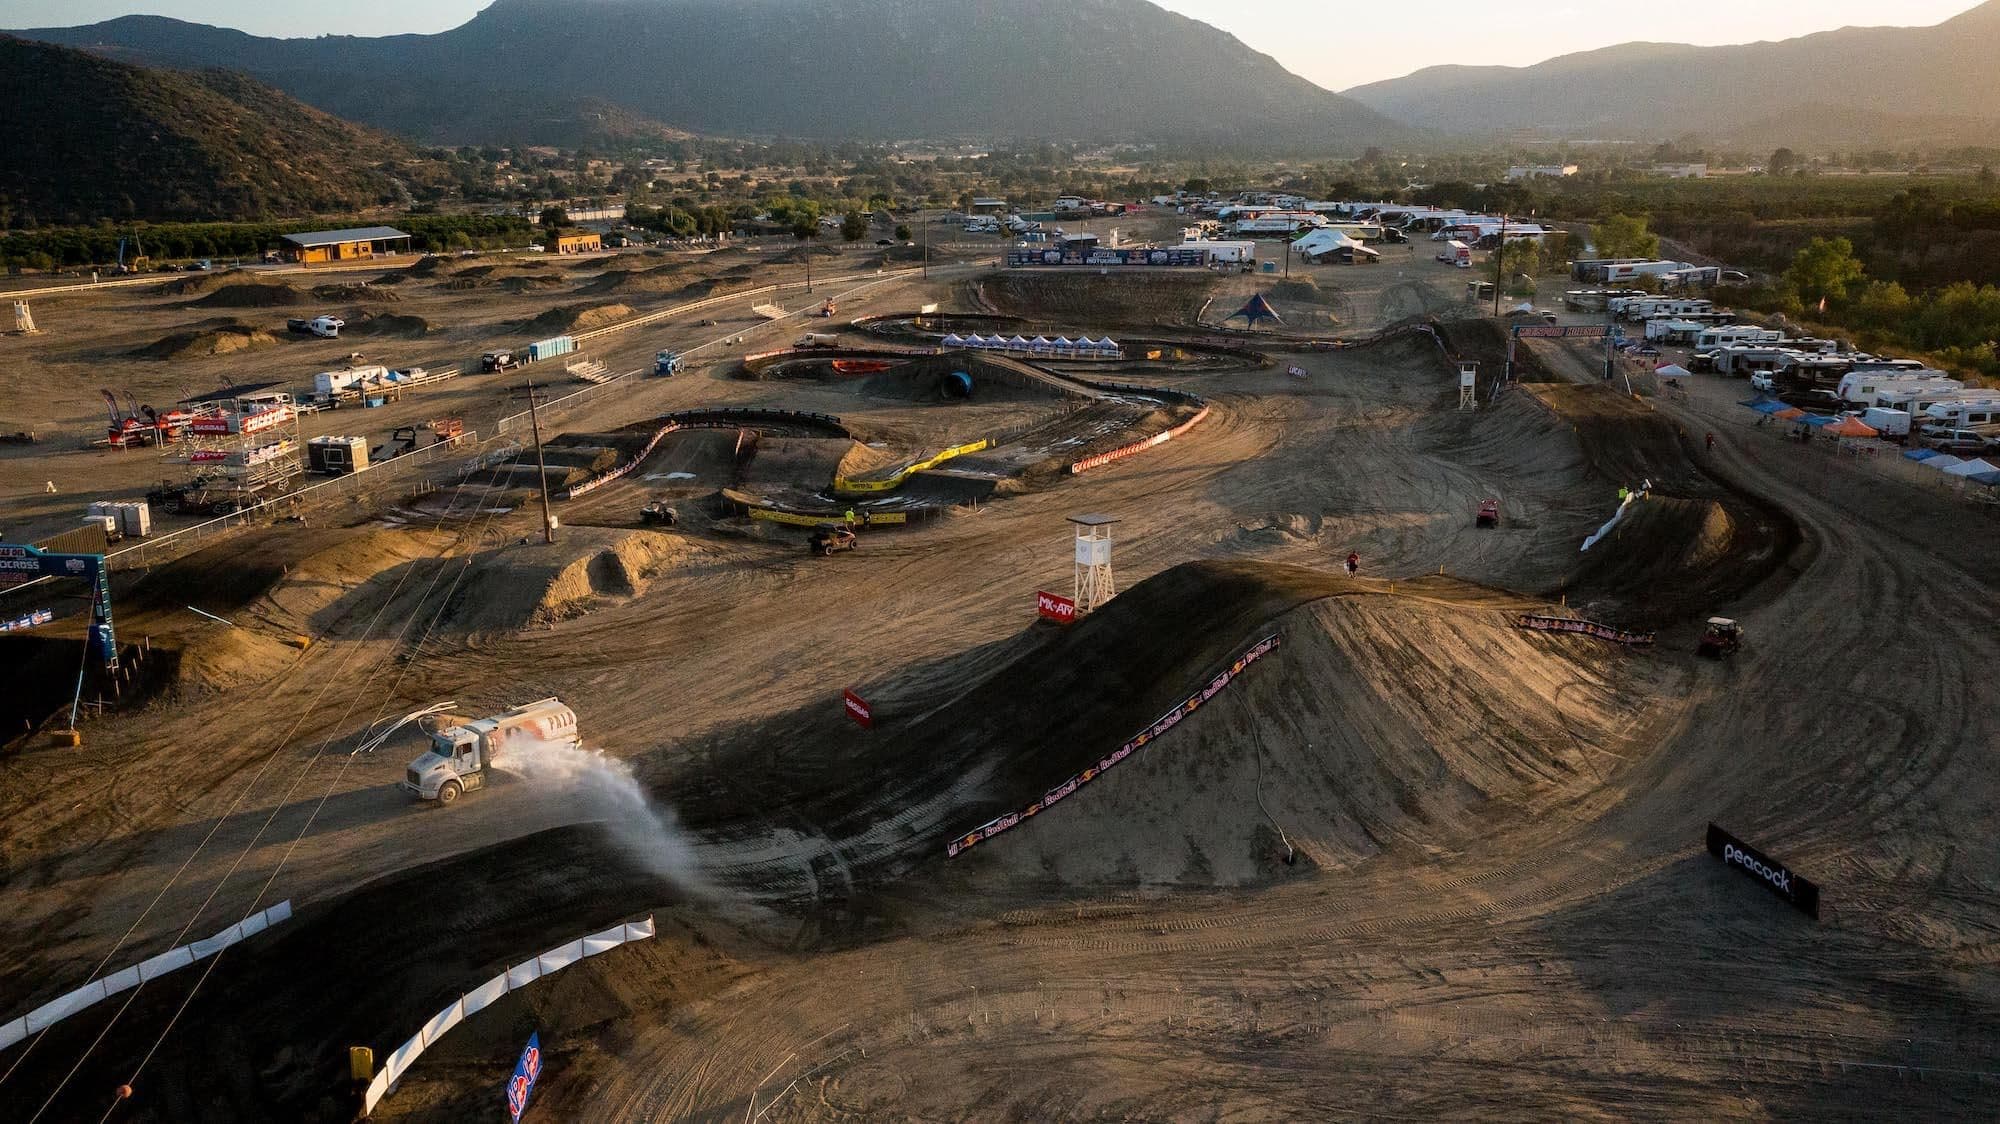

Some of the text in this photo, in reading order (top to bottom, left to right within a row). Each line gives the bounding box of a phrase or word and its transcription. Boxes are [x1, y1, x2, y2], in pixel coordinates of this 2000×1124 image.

[1039, 596, 1073, 616] MX-ATV
[547, 711, 574, 730] PALA
[1724, 843, 1789, 892] peacock
